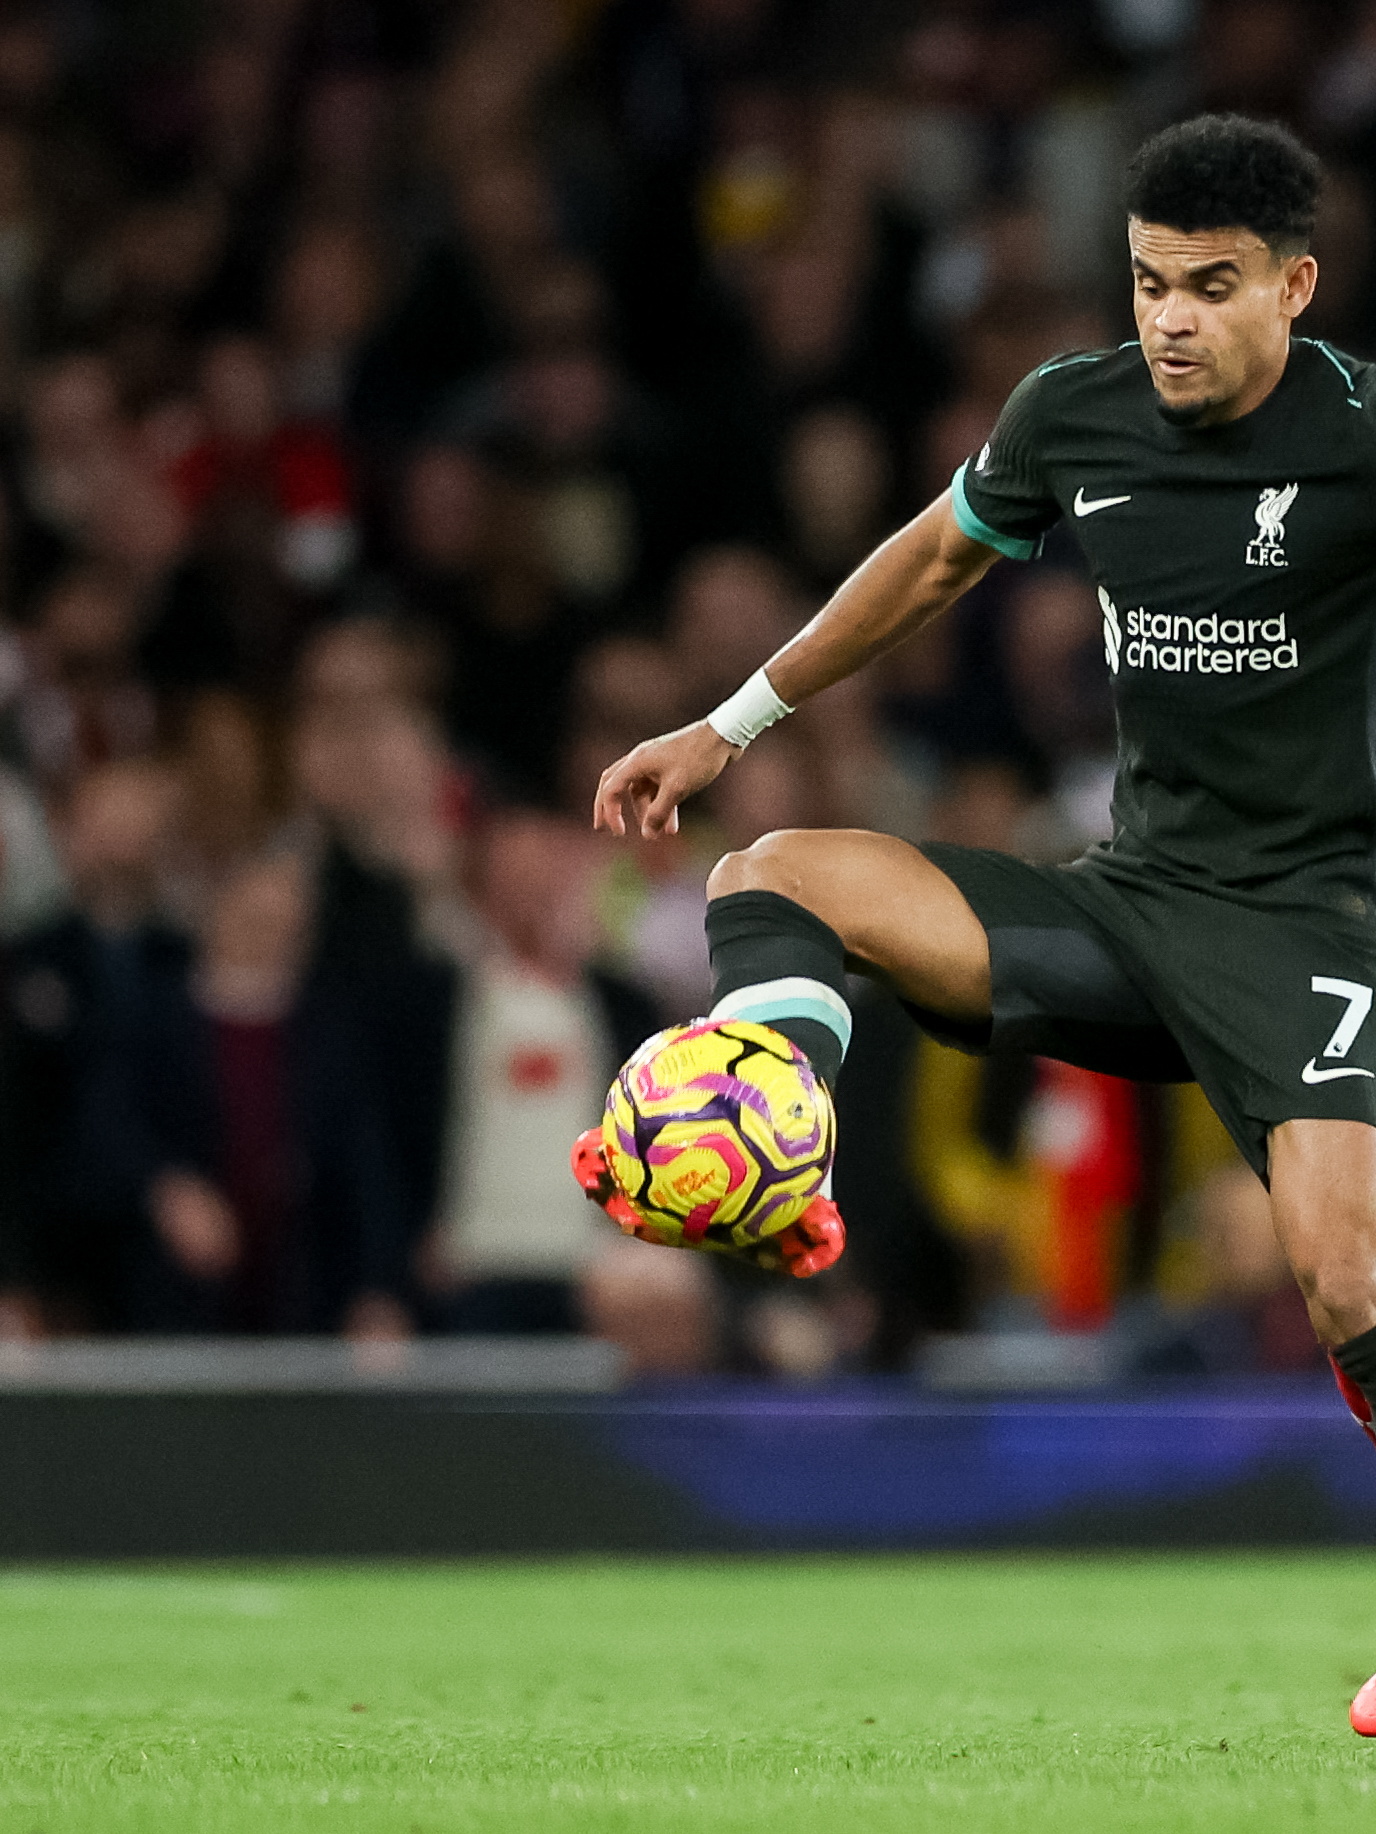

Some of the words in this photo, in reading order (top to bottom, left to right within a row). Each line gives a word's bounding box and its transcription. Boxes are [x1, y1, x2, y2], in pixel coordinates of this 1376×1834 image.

[1127, 606, 1286, 644] standard
[1126, 638, 1298, 674] chartered
[1311, 975, 1373, 1058] 7
